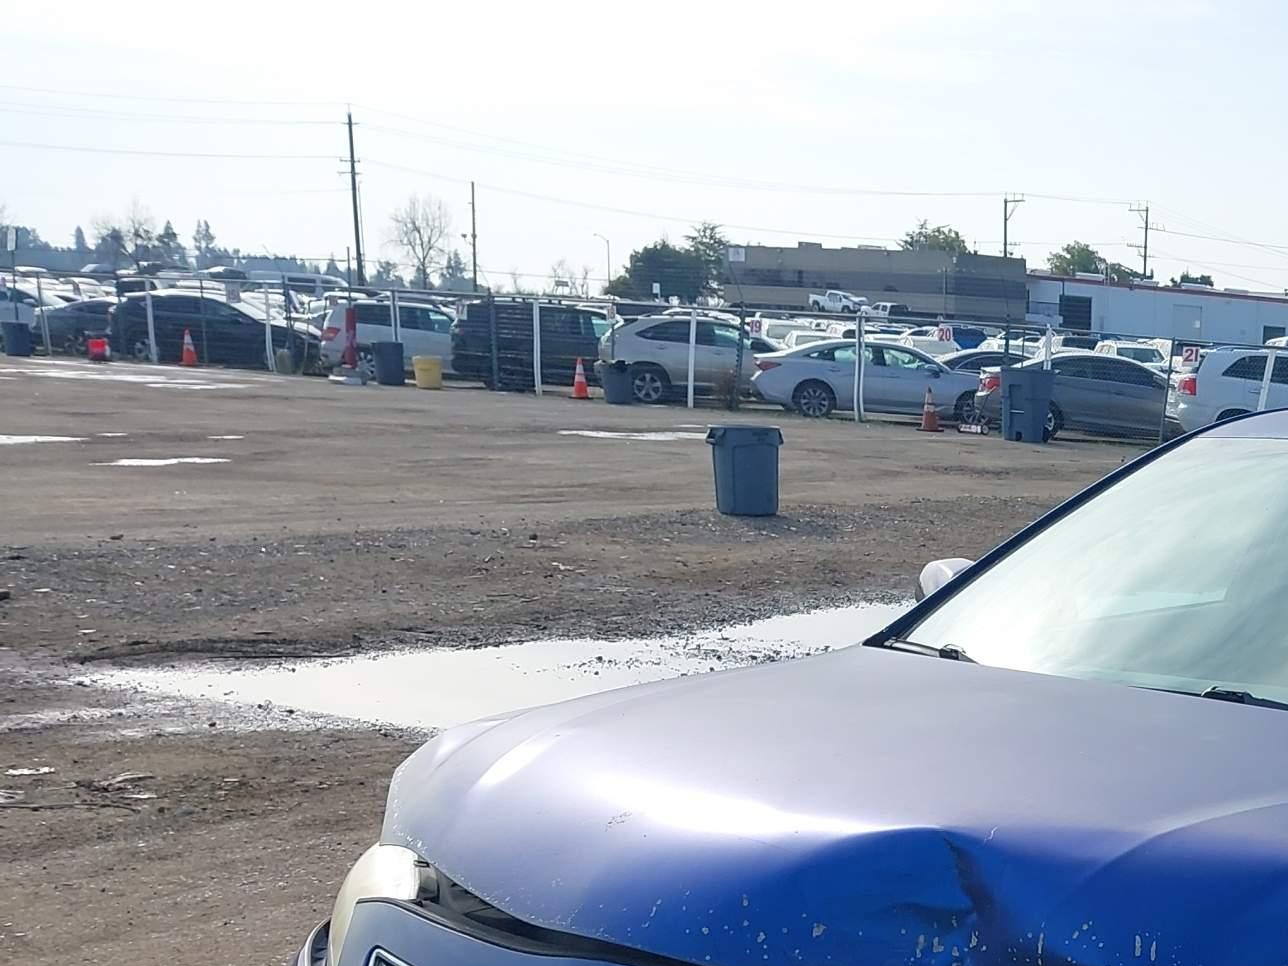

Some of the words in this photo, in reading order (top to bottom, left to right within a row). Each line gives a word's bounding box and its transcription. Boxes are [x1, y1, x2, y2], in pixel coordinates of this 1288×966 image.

[750, 320, 762, 334] 19
[938, 328, 951, 342] 20
[1183, 348, 1199, 363] 21
